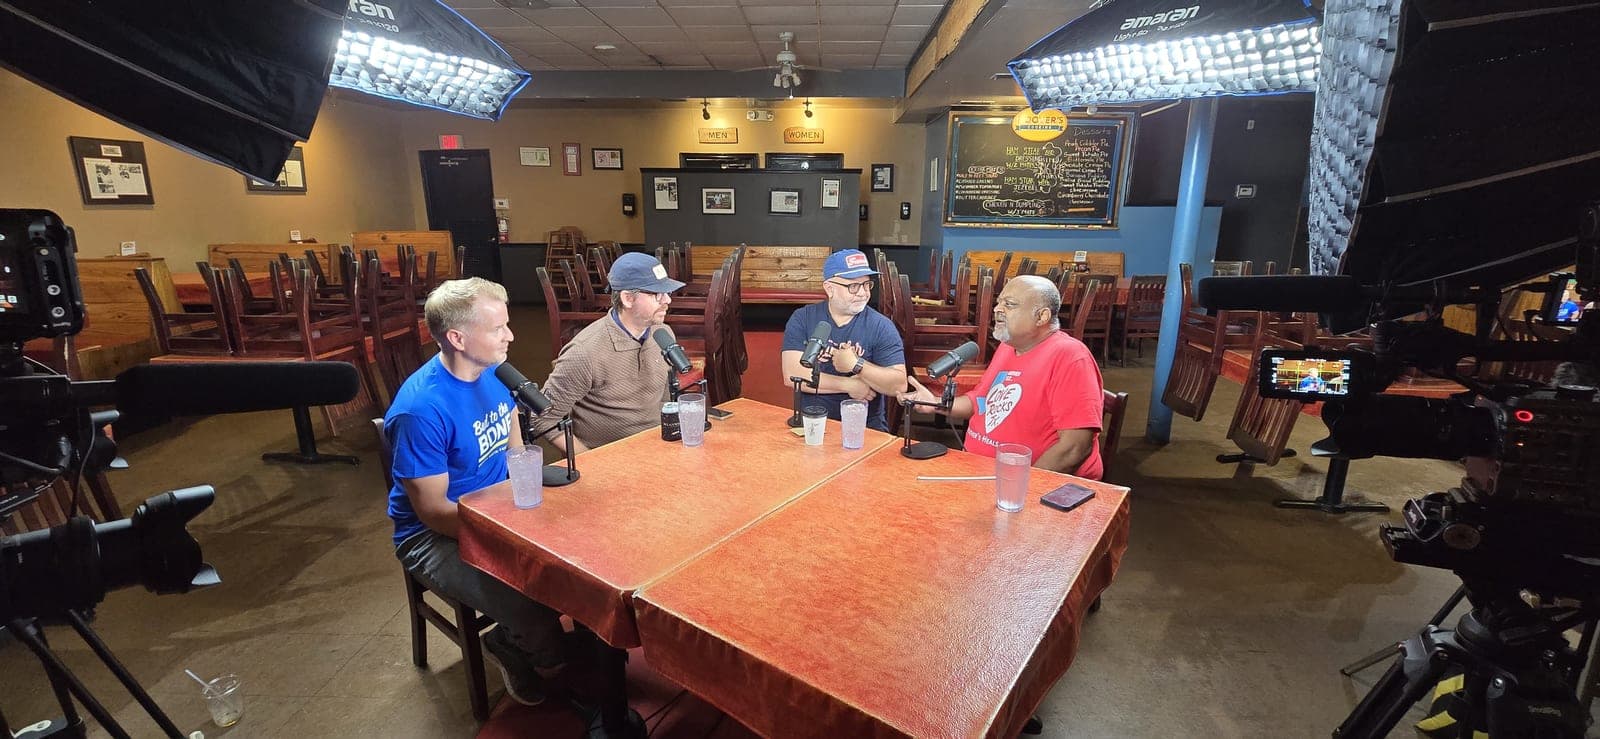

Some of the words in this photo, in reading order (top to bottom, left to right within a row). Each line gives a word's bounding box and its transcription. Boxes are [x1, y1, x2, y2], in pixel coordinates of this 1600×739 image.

[348, 0, 395, 20] ran
[1120, 5, 1200, 30] amaran
[789, 131, 820, 139] WOMEN
[489, 410, 499, 424] to
